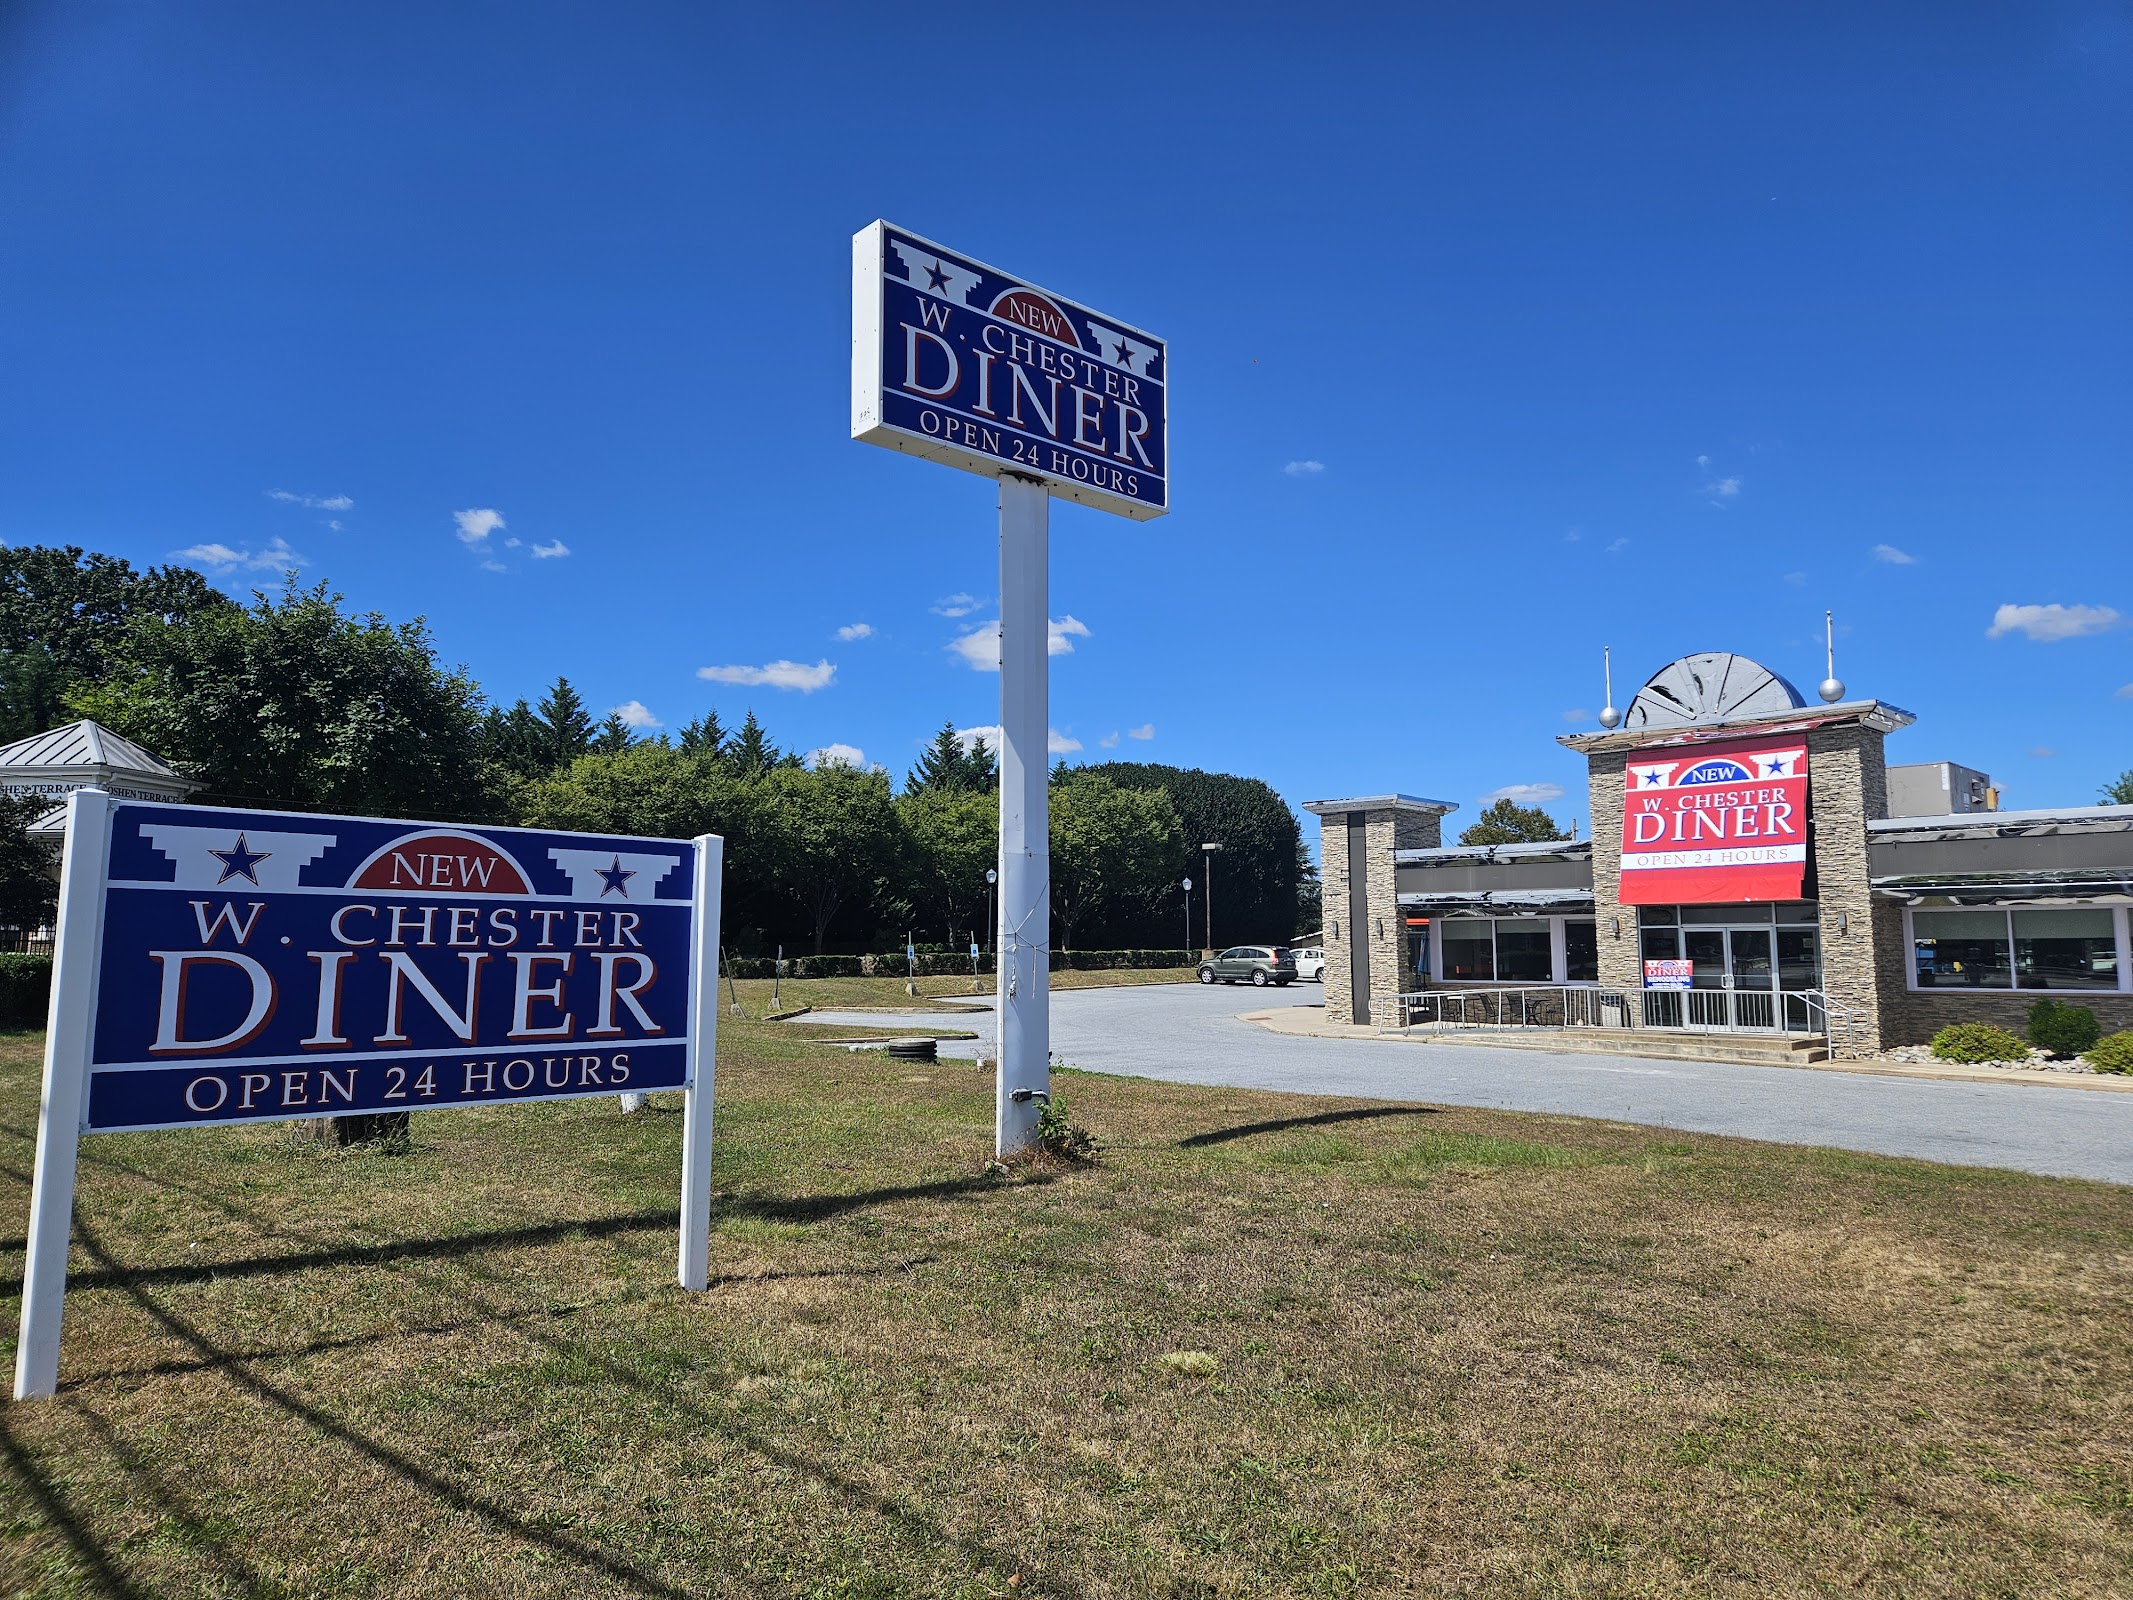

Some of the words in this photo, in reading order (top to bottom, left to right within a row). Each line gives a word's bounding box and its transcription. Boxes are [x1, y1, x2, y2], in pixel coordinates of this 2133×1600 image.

[1009, 296, 1062, 337] NEW
[915, 295, 965, 341] W.
[982, 324, 1142, 407] CHESTER
[899, 321, 1155, 471] DINER
[919, 410, 1001, 455] OPEN
[1013, 439, 1039, 466] 24
[1051, 450, 1139, 496] HOURS
[1691, 765, 1737, 783] NEW
[1642, 797, 1671, 813] W.
[1678, 787, 1787, 811] CHESTER
[1633, 803, 1796, 844] DINER
[390, 851, 499, 888] NEW
[1637, 853, 1687, 867] OPEN
[1694, 852, 1713, 864] 24
[1722, 848, 1789, 862] HOURS
[188, 901, 293, 945] W.
[330, 904, 644, 948] CHESTER
[1648, 968, 1689, 976] DINER
[149, 950, 664, 1056] DINER
[184, 1068, 358, 1113] OPEN
[384, 1064, 438, 1099] 24
[462, 1053, 631, 1094] HOURS
